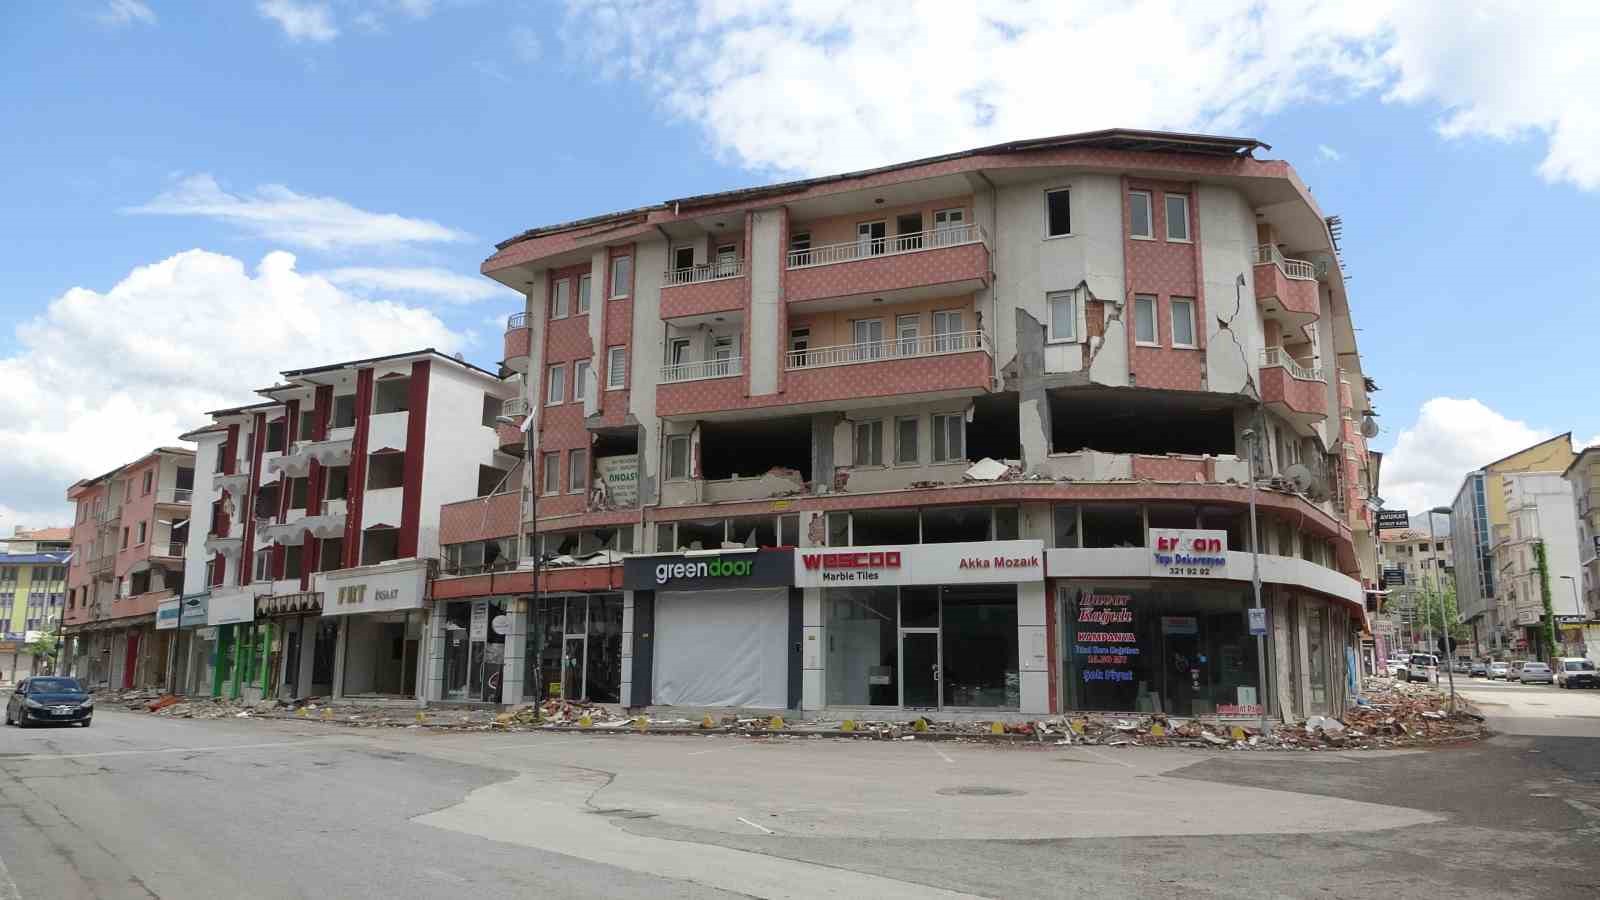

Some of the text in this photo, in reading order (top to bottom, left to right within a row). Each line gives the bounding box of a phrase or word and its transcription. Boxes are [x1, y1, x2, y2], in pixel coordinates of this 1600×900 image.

[959, 558, 991, 568] Akka
[656, 558, 753, 584] greendoor
[822, 571, 880, 581] Marble Tiles
